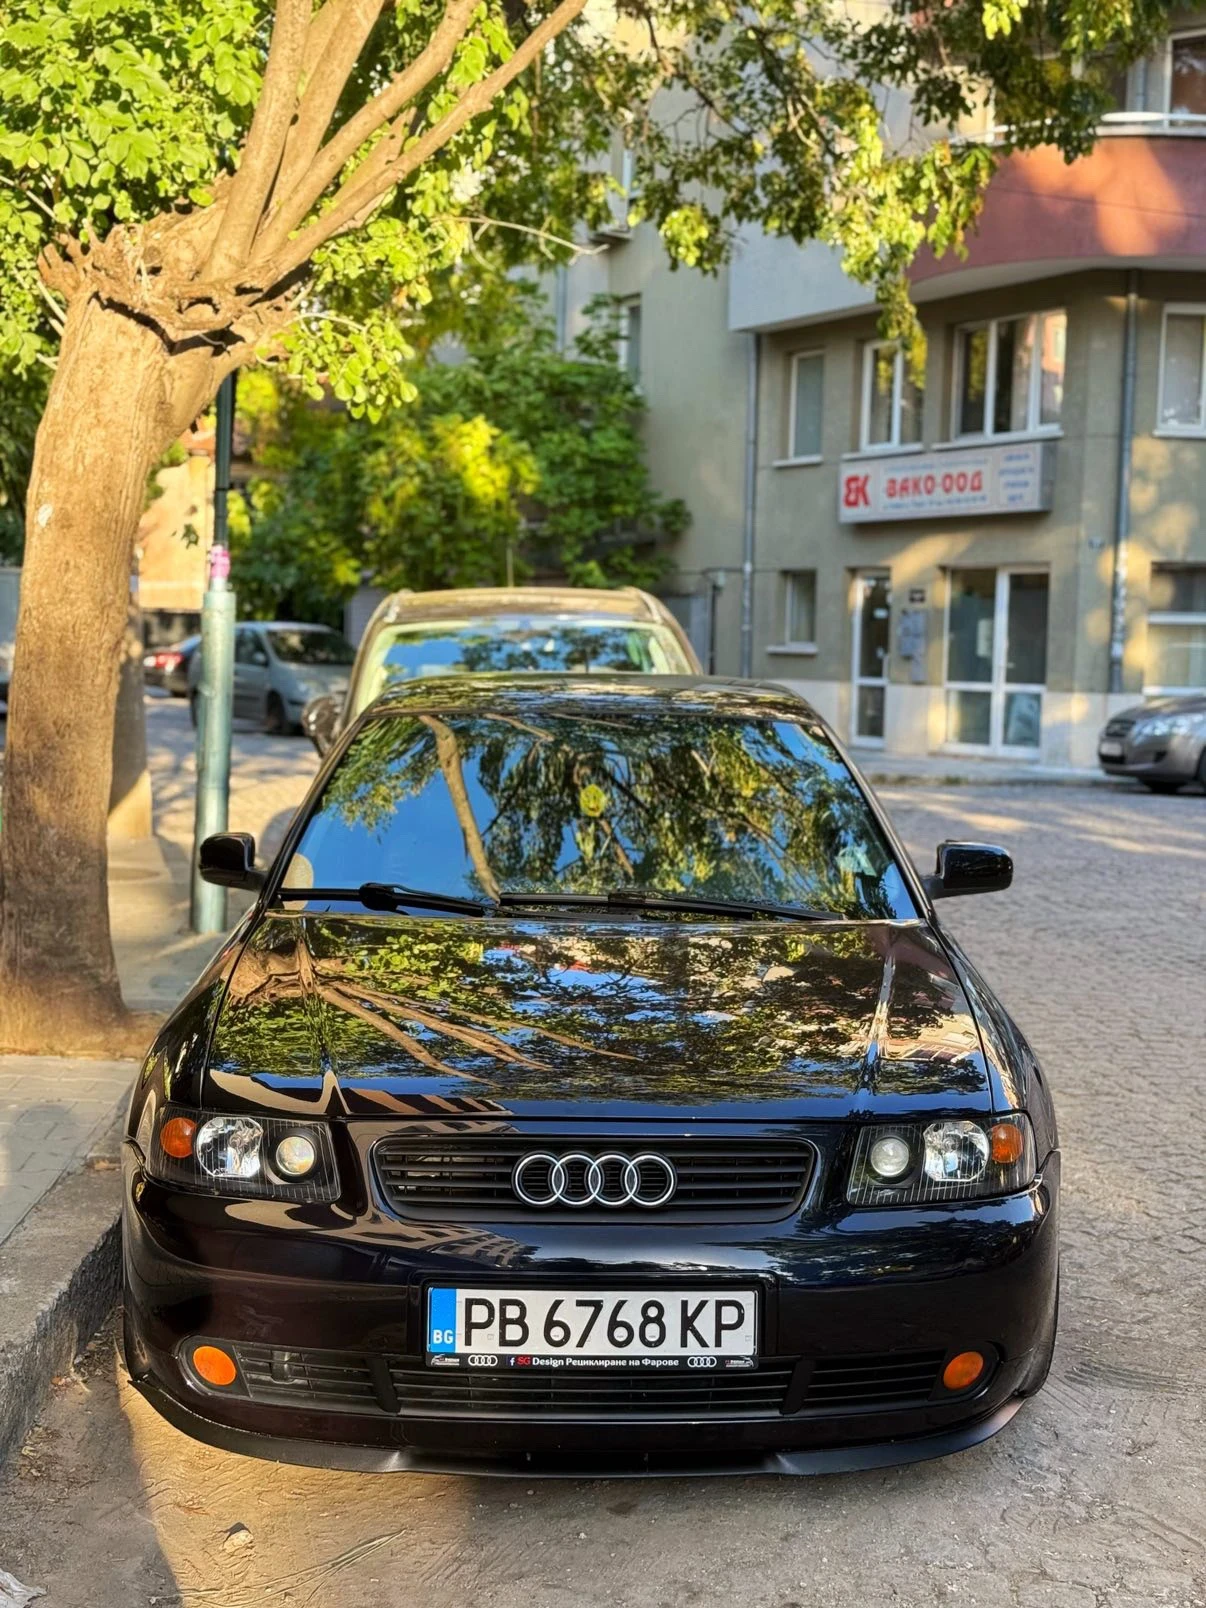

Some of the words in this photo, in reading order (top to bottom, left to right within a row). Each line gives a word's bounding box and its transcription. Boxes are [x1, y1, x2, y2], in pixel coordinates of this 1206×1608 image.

[464, 1297, 529, 1347] PB
[543, 1298, 666, 1348] 6768
[680, 1299, 746, 1348] KP
[432, 1329, 454, 1344] BG
[517, 1356, 531, 1365] SG
[532, 1357, 564, 1368] Design
[565, 1358, 627, 1368] Рециклиране
[641, 1358, 679, 1368] Фарове
